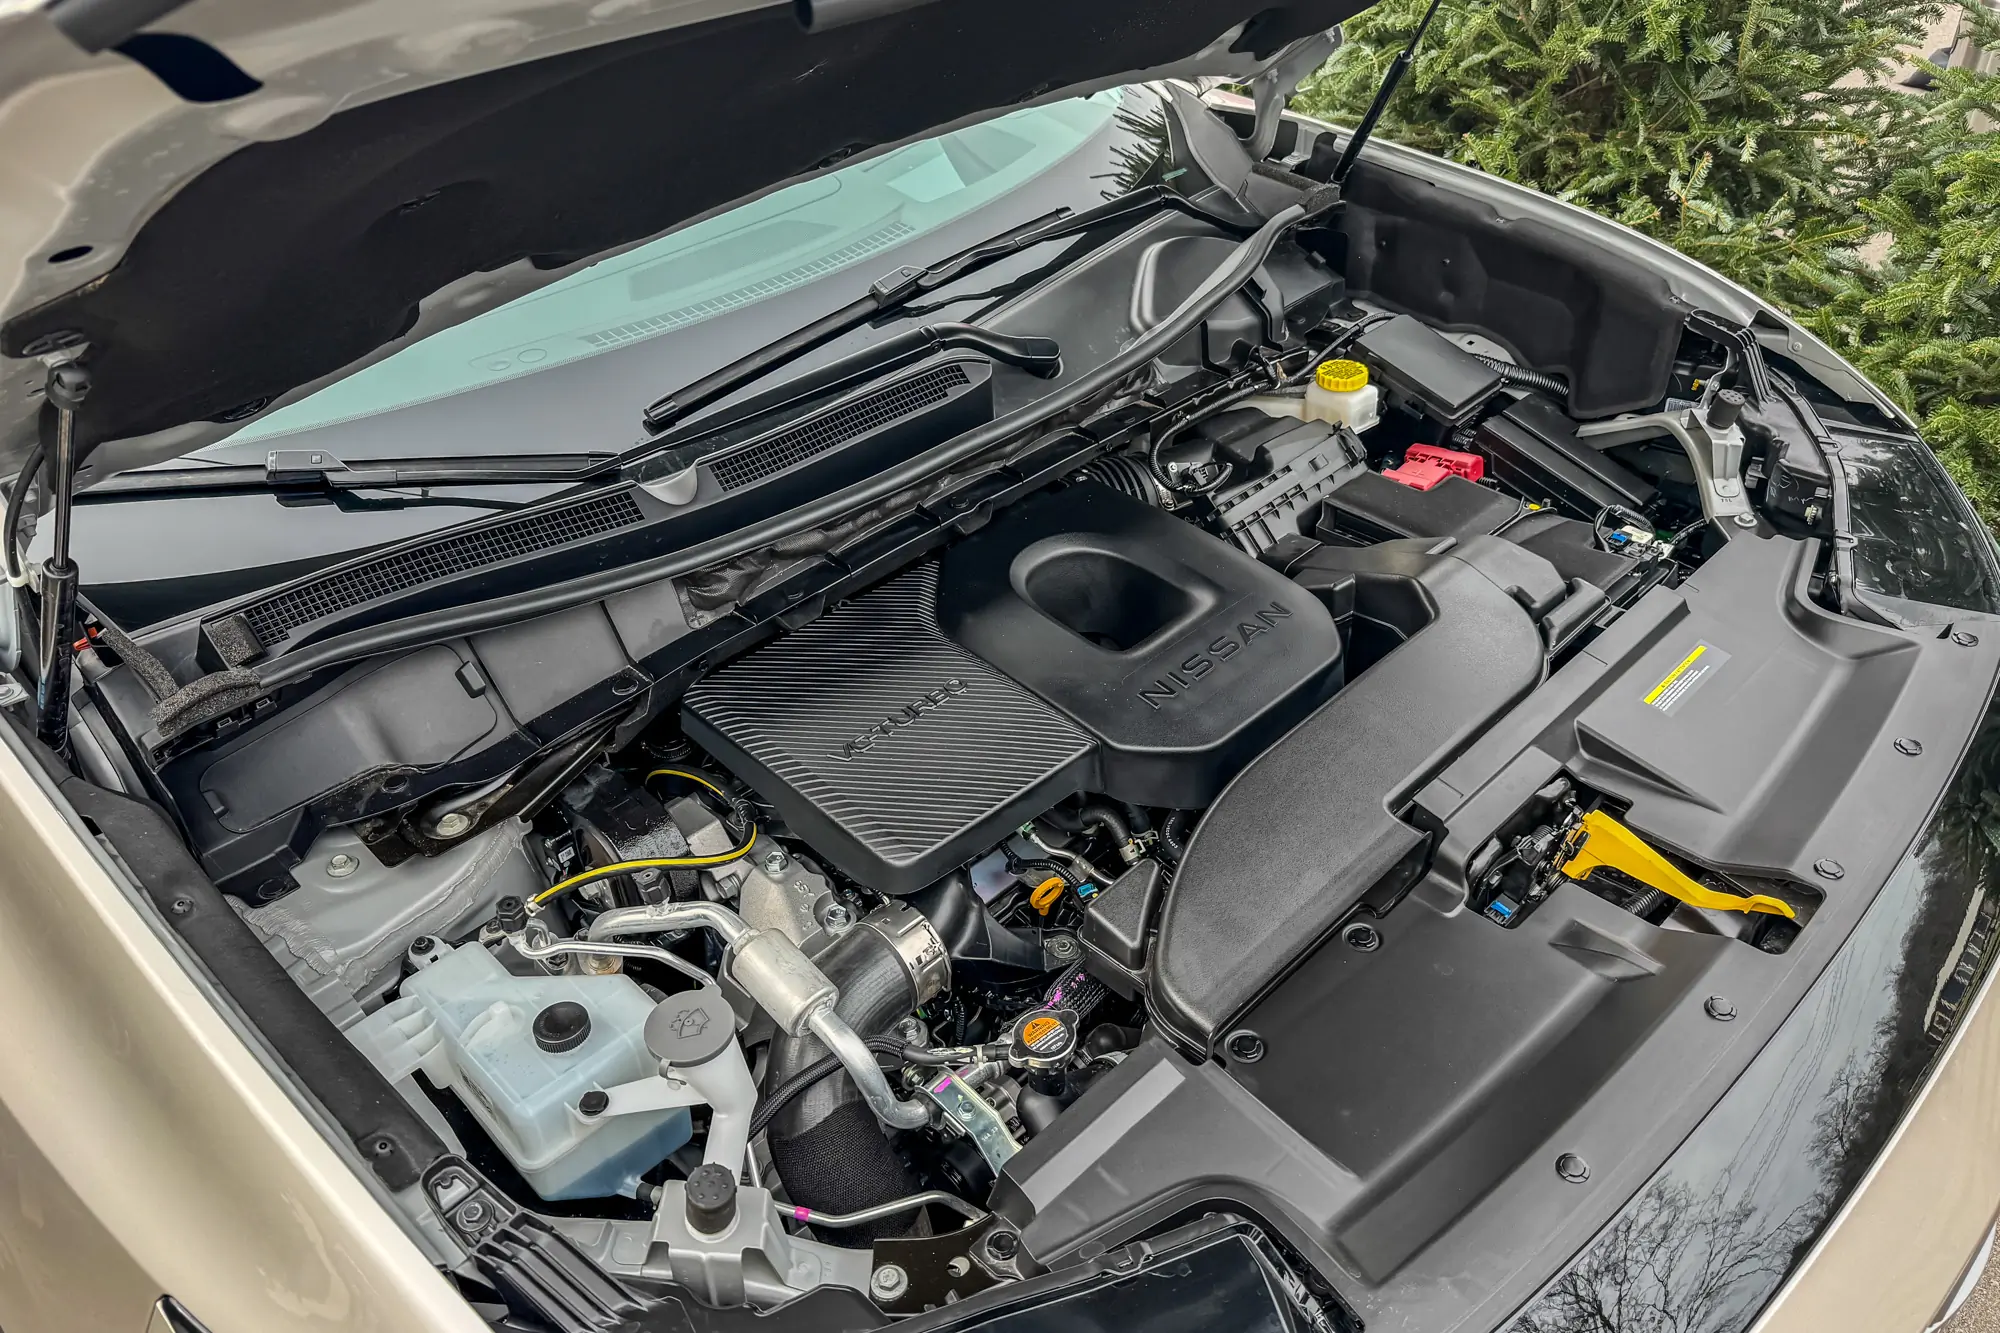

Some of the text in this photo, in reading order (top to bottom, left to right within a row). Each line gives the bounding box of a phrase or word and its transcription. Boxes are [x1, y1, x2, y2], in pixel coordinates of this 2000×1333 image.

[1137, 601, 1293, 710] NISSAN
[826, 678, 967, 762] VC-TURBO
[1027, 1020, 1051, 1037] WARNING
